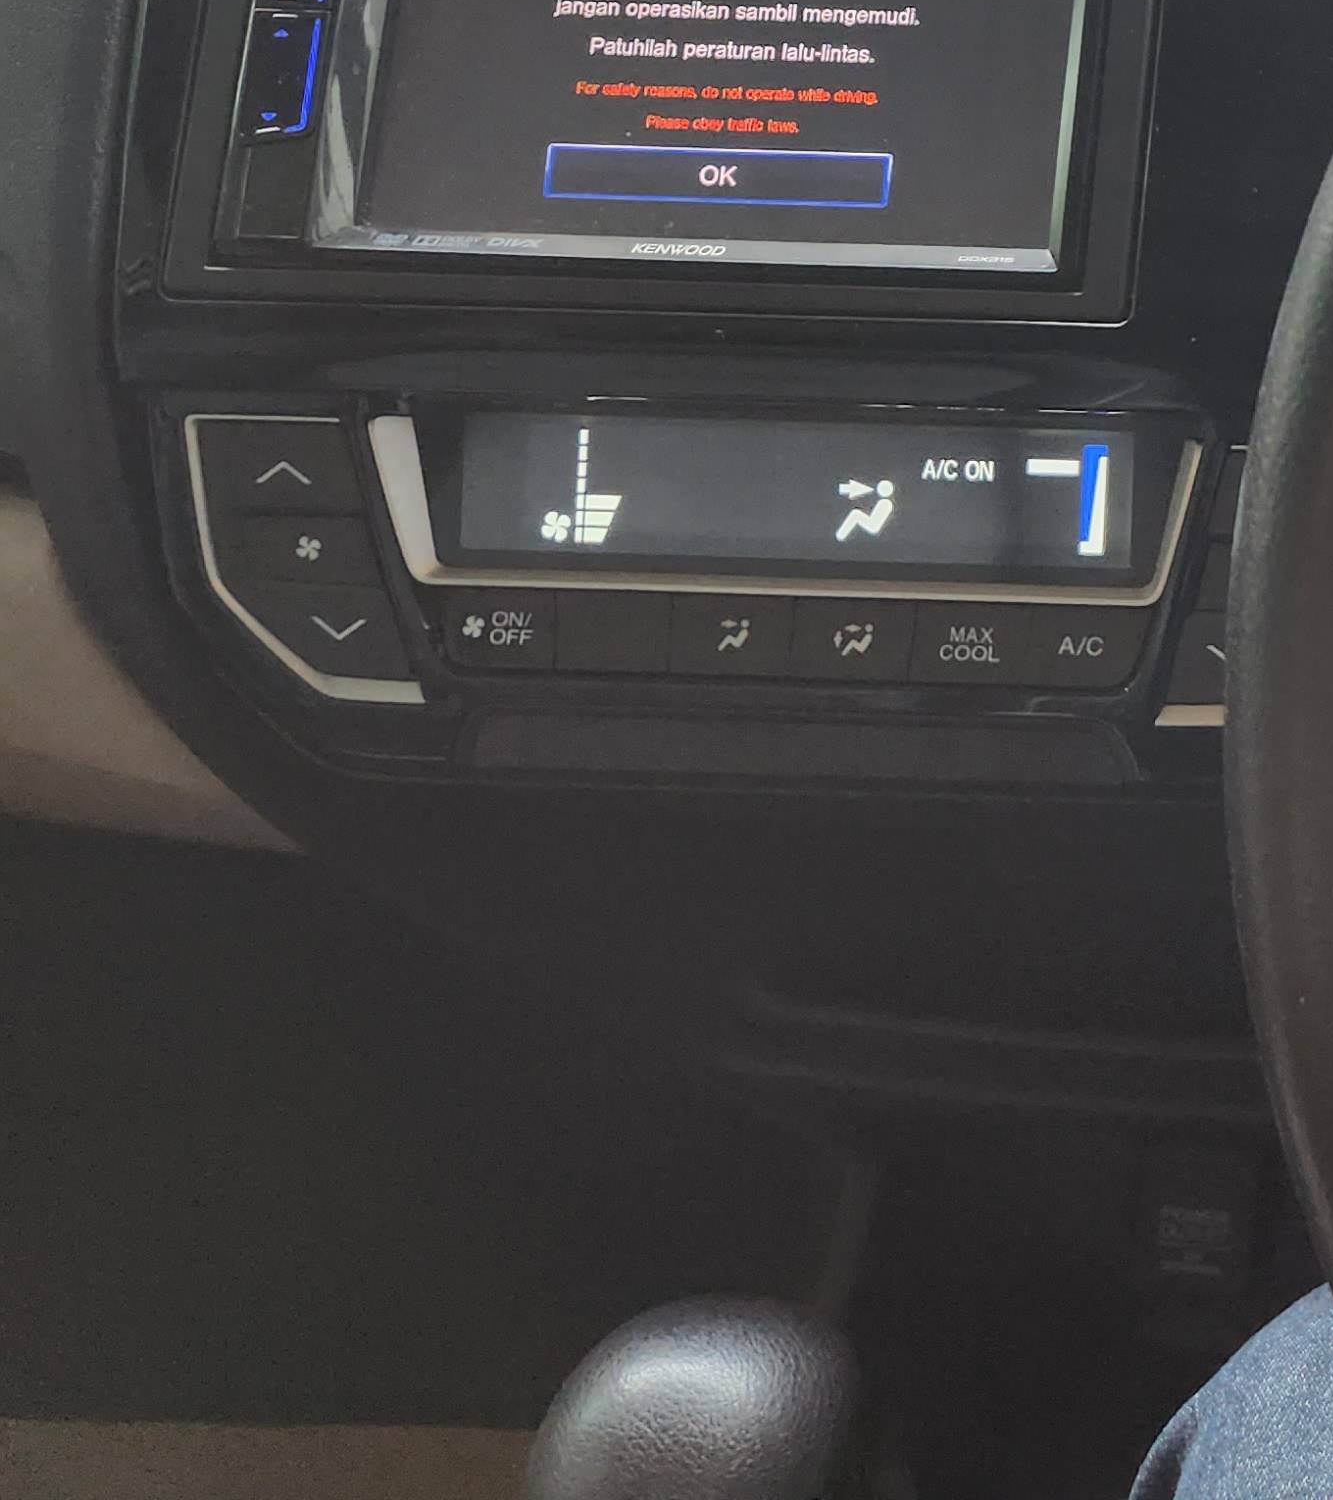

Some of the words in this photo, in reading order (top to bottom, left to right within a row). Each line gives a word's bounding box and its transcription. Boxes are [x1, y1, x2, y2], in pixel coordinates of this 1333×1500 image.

[624, 0, 729, 20] operasikan
[735, 3, 798, 22] sambil
[802, 7, 920, 26] mengemudi.
[589, 36, 677, 57] Patuhilah
[682, 40, 776, 60] peraturan
[781, 43, 876, 63] lalu-lintas.
[575, 80, 600, 95] For
[701, 86, 719, 99] do
[722, 86, 743, 100] not
[745, 88, 795, 102] operate
[798, 88, 831, 103] while
[645, 114, 690, 130] Please
[692, 116, 725, 132] obey
[727, 116, 764, 132] traffic
[699, 164, 738, 187] OK
[631, 243, 726, 256] KENWOOD
[921, 458, 958, 481] A/C
[964, 460, 994, 482] ON
[489, 628, 534, 645] OFF
[950, 626, 994, 643] MAX
[939, 644, 1000, 663] COOL
[1058, 636, 1104, 656] A/C
